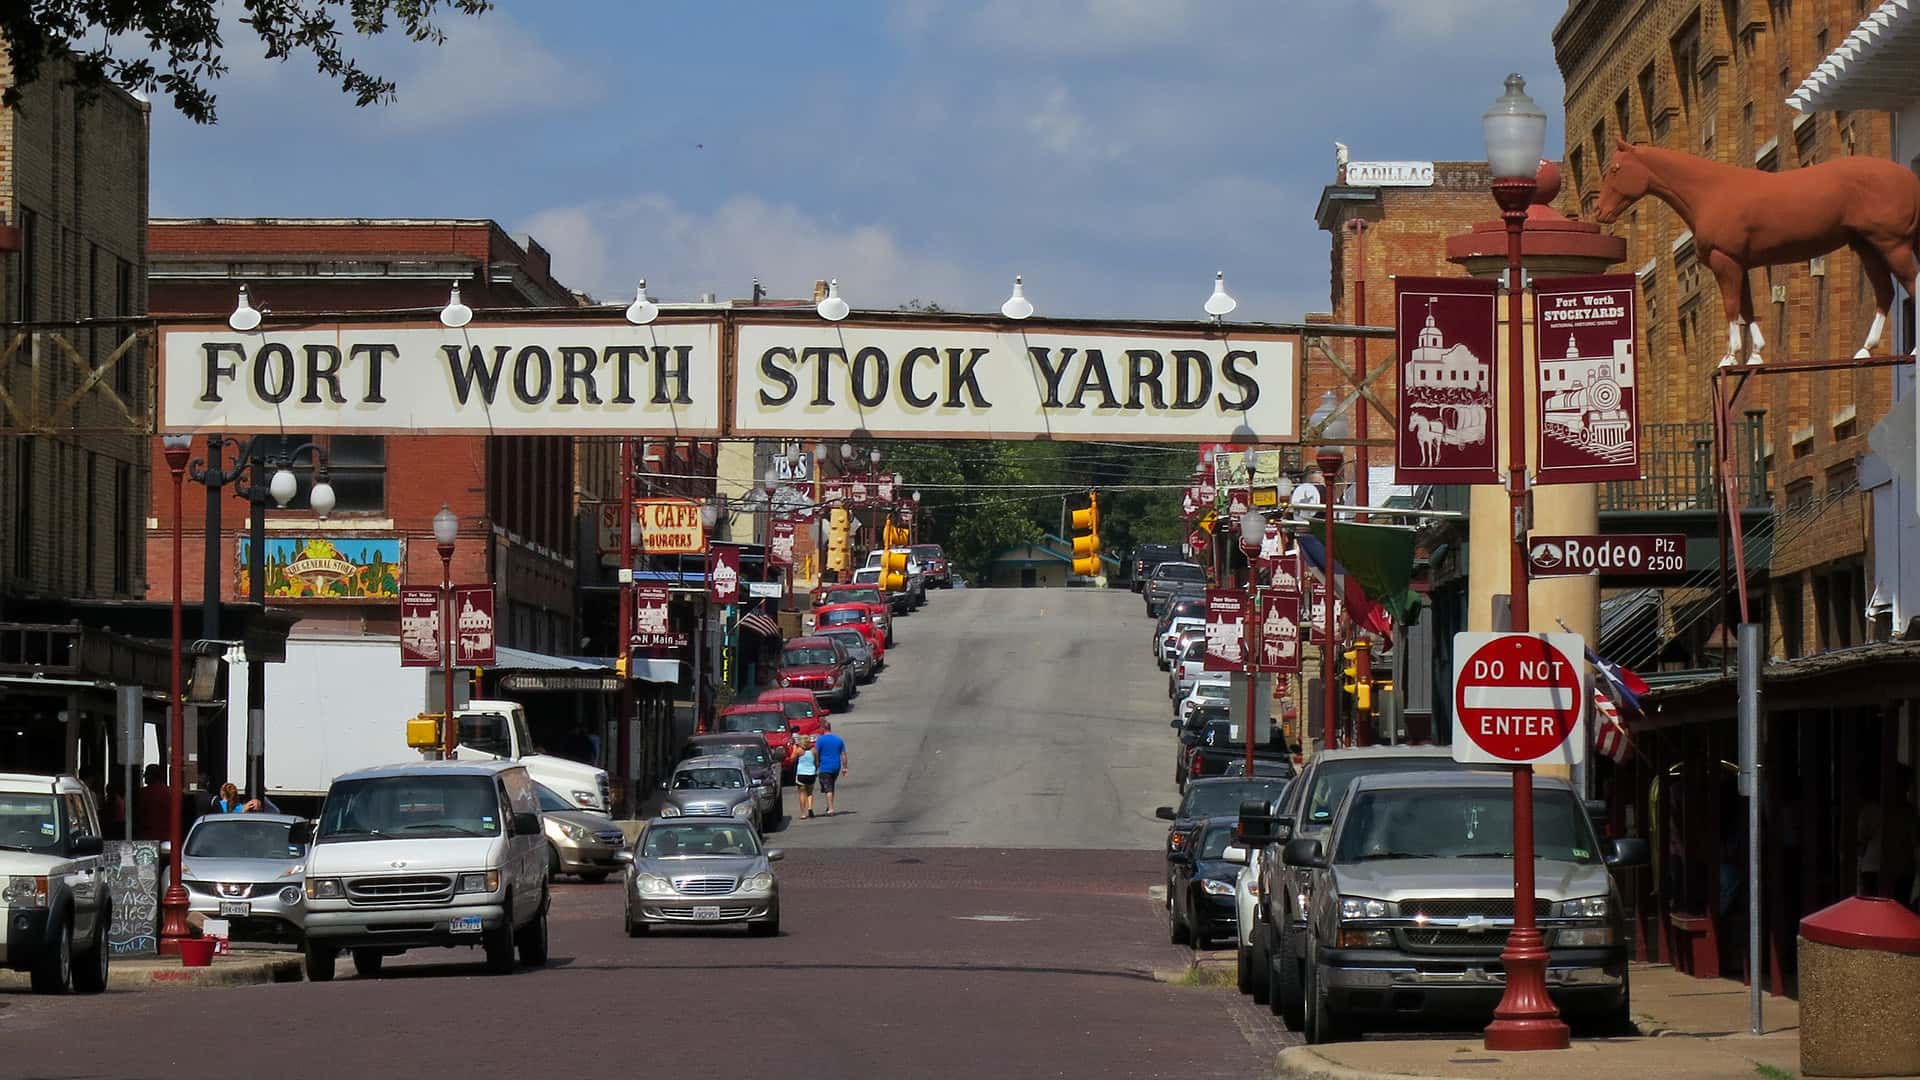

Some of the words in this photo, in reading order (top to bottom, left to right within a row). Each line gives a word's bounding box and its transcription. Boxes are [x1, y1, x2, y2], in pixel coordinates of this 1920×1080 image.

[1555, 297, 1577, 308] Fort
[1583, 295, 1614, 306] Worth
[1544, 307, 1625, 321] STOCKYARDS
[200, 342, 400, 403] FORT
[440, 343, 694, 405] WORTH
[758, 346, 993, 407] STOCK
[1027, 347, 1261, 411] YARDS
[603, 505, 647, 528] STR
[655, 505, 698, 528] CAFE
[1564, 540, 1641, 568] Rodeo
[1655, 538, 1675, 553] Plz
[1647, 556, 1683, 571] 2500
[653, 634, 673, 645] Main
[1475, 660, 1504, 680] DO
[1519, 660, 1564, 681] NOT
[1481, 715, 1554, 737] ENTER
